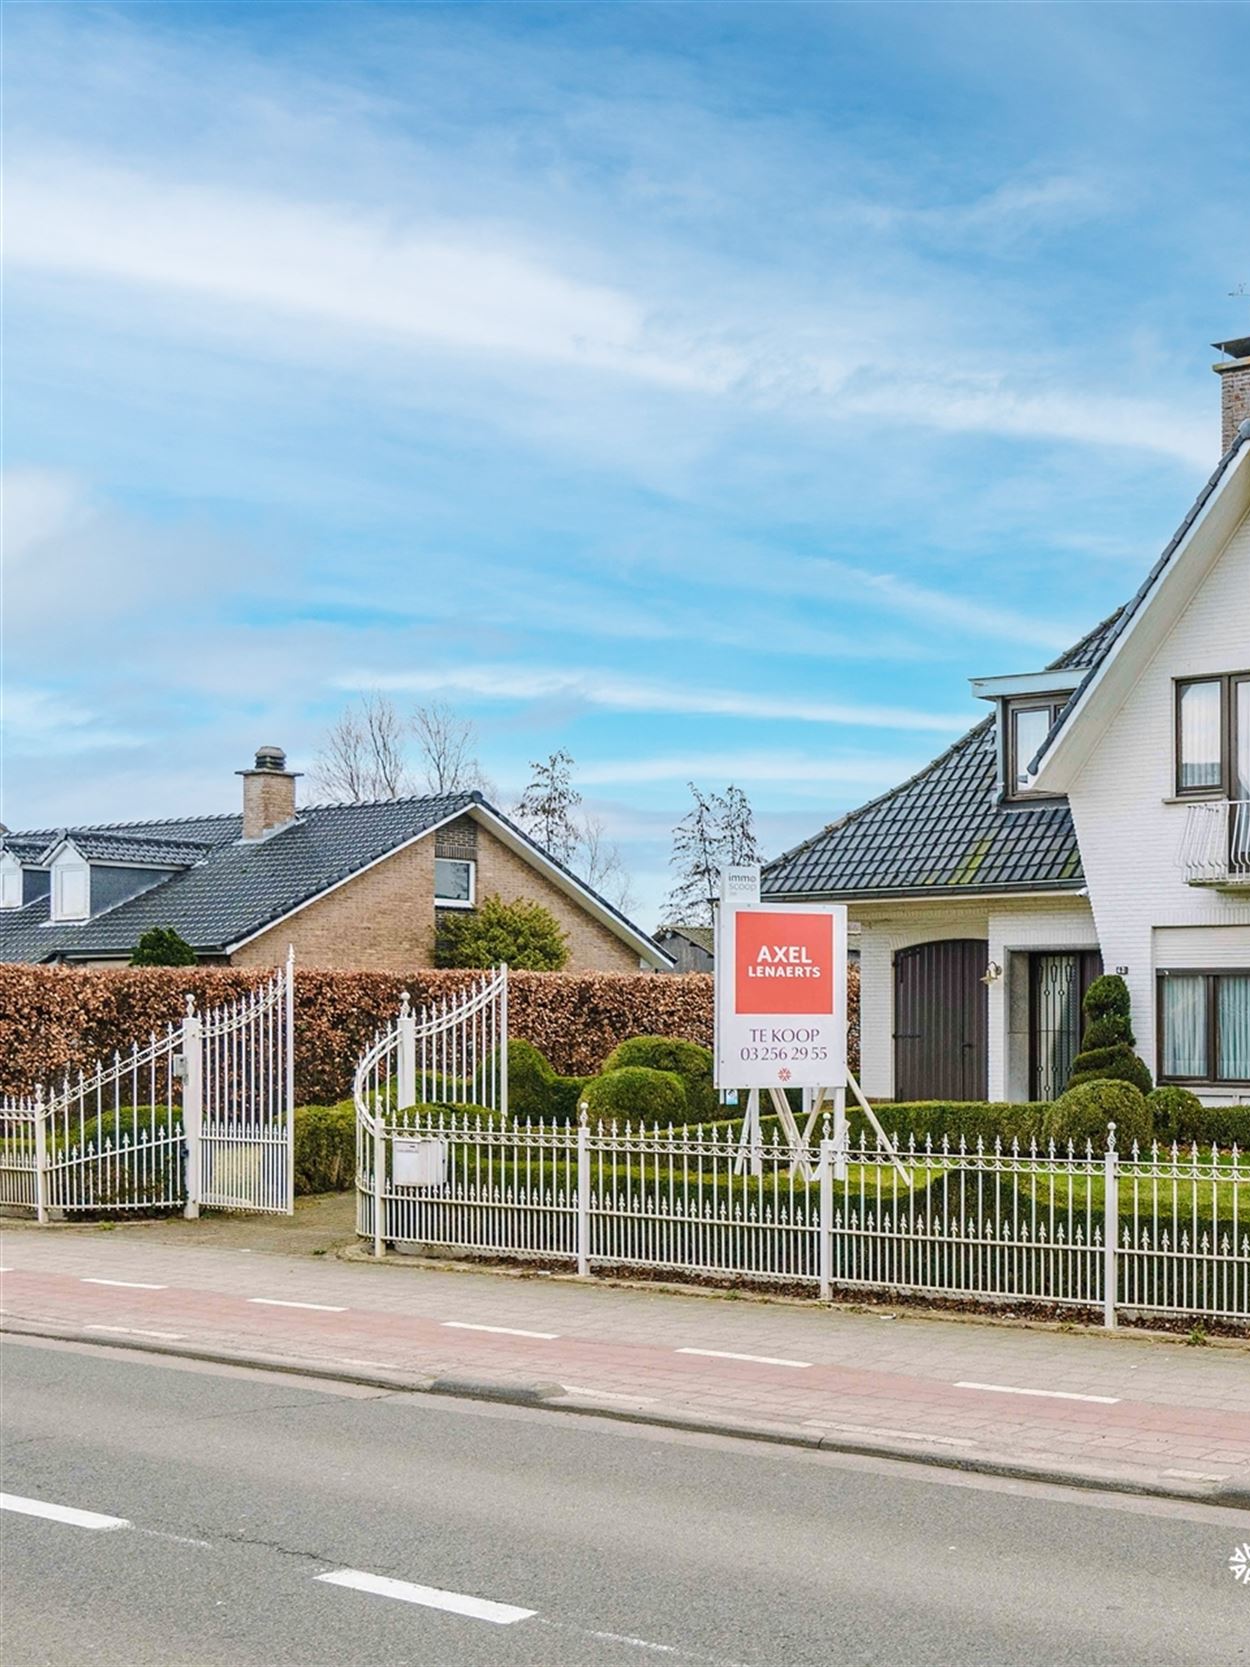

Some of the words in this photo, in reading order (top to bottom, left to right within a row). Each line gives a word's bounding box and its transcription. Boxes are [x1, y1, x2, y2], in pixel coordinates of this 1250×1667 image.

[757, 945, 812, 963] AXEL
[748, 966, 821, 978] LENAERTS
[749, 1029, 768, 1043] TE
[771, 1028, 820, 1043] KOOP
[740, 1047, 759, 1061] 03
[761, 1047, 788, 1061] 256
[791, 1046, 809, 1061] 29
[811, 1046, 828, 1061] 55
